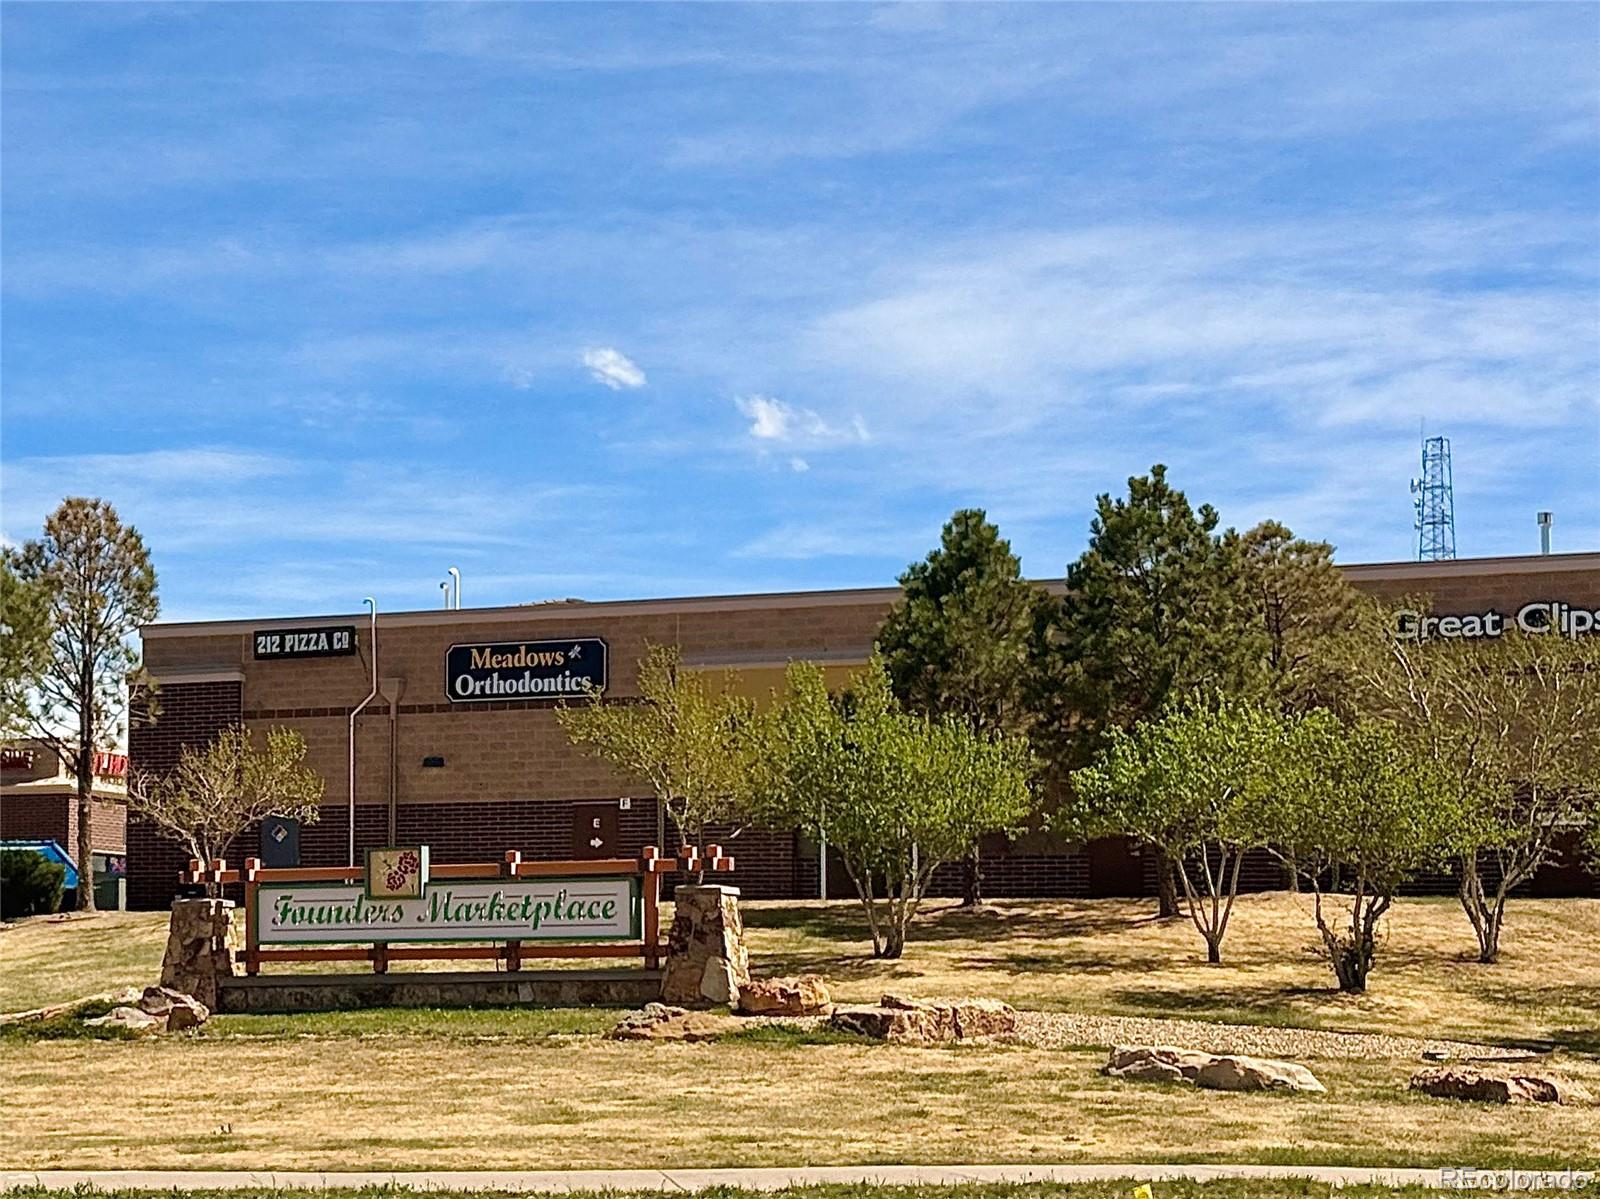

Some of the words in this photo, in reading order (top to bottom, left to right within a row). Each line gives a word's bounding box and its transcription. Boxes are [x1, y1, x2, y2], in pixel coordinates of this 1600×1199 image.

[1390, 609, 1500, 640] Great
[257, 635, 280, 653] 212
[284, 633, 329, 652] PIZZA
[470, 645, 564, 670] Meadows
[455, 670, 592, 696] Orthodontics
[272, 894, 404, 926] Founders
[417, 889, 617, 930] Marketplace
